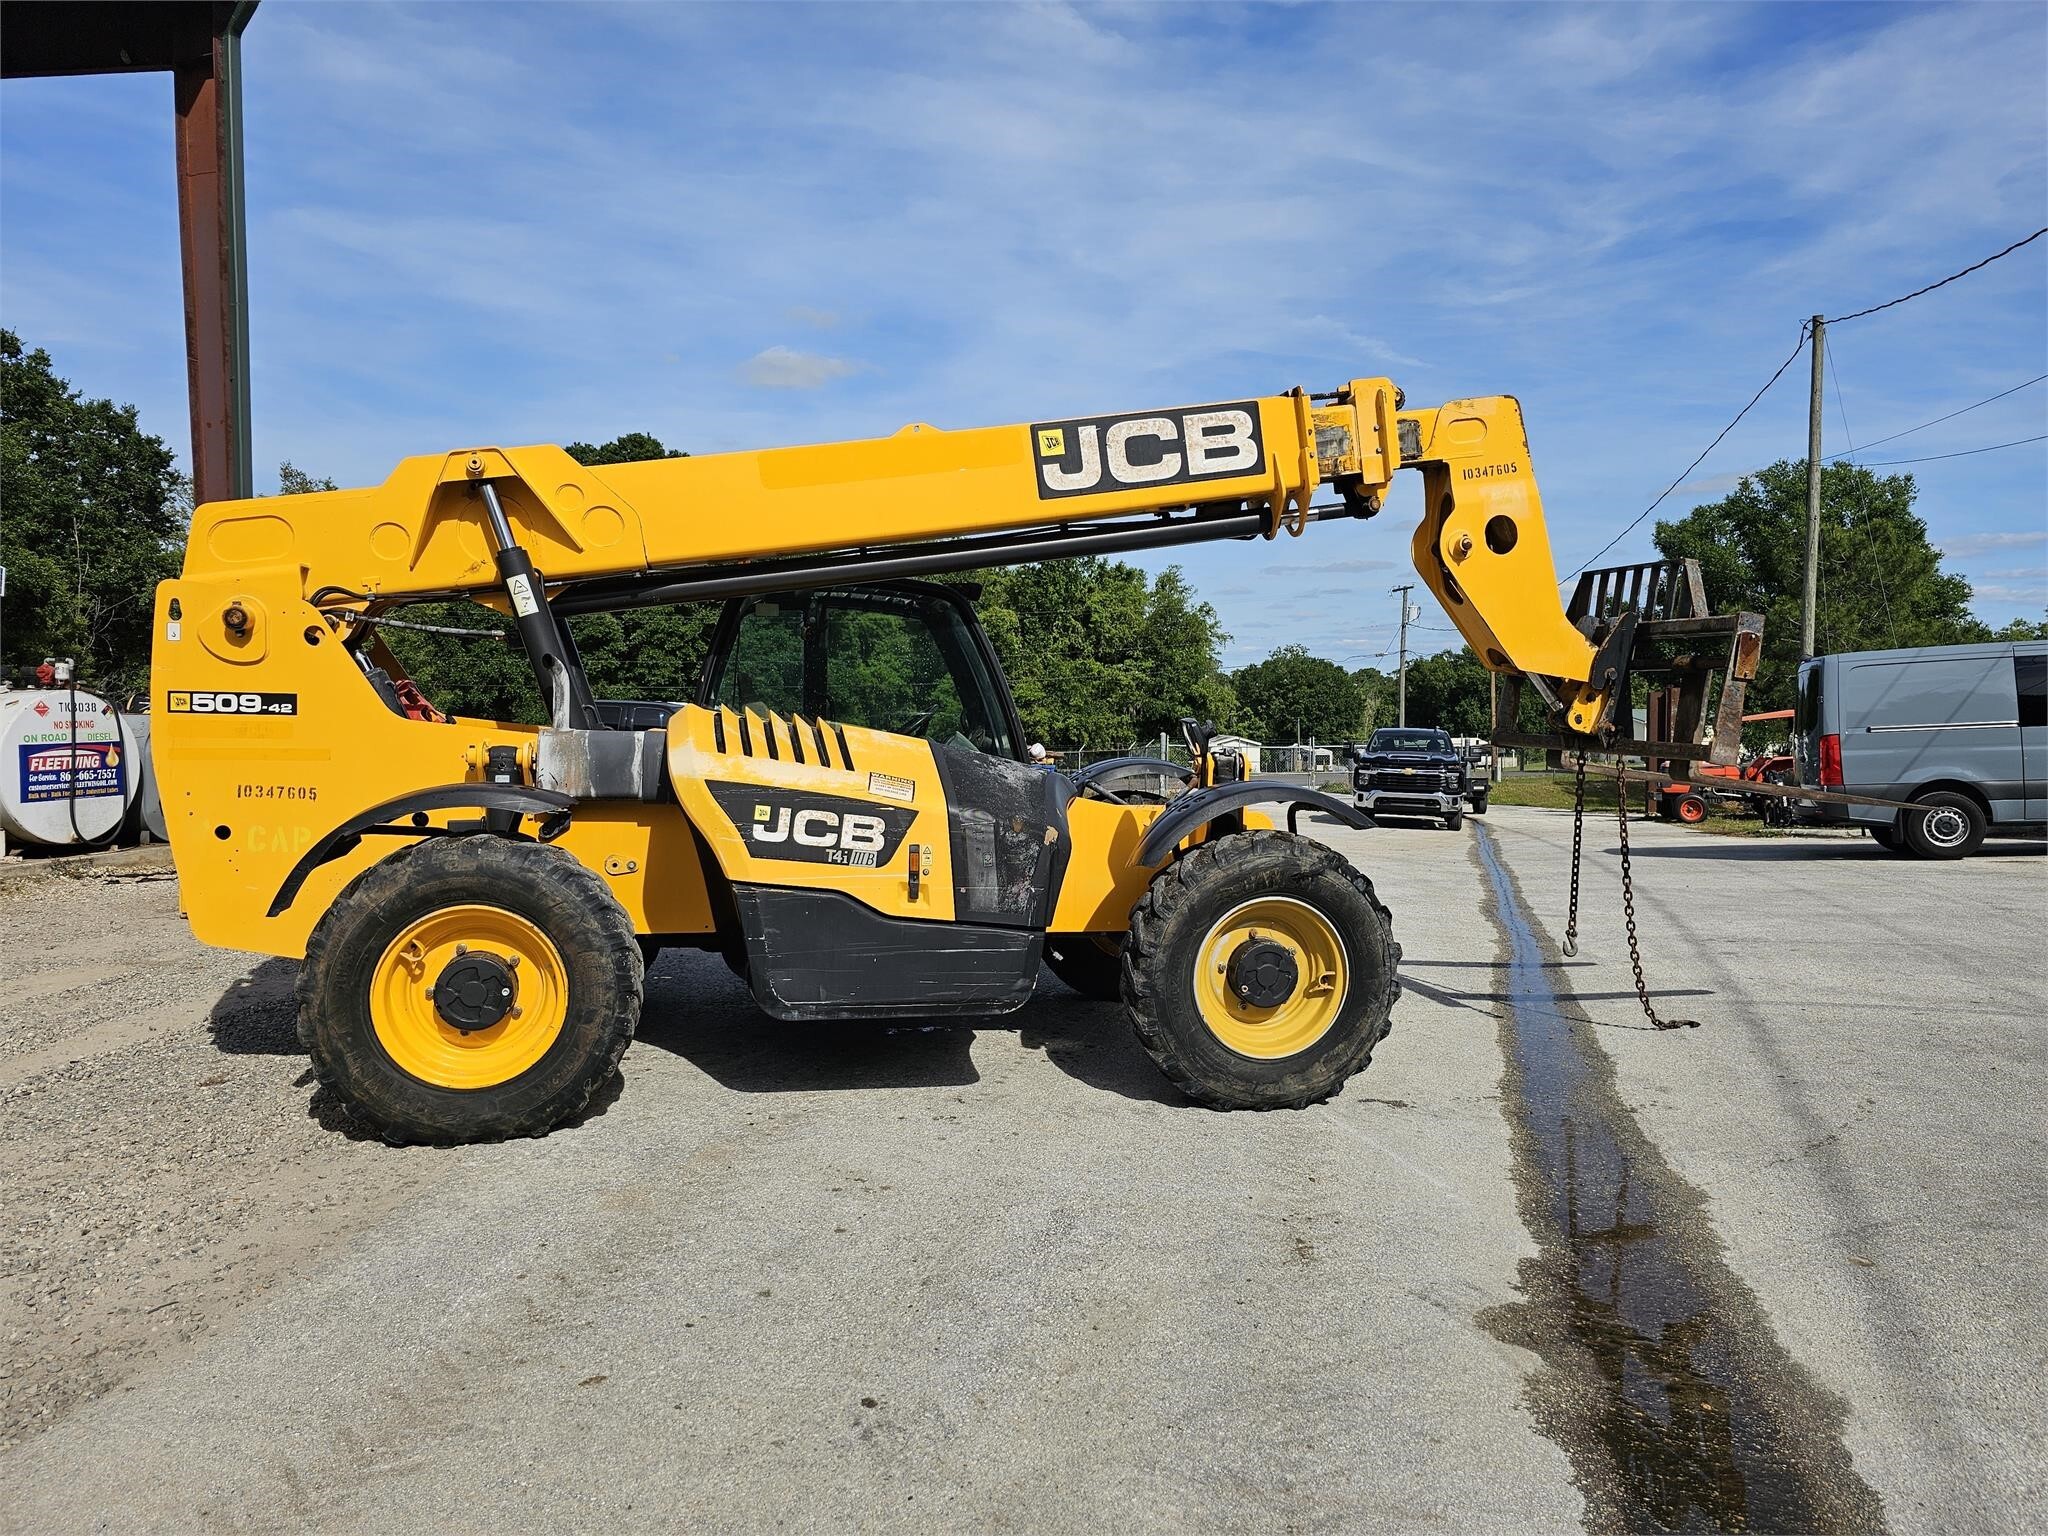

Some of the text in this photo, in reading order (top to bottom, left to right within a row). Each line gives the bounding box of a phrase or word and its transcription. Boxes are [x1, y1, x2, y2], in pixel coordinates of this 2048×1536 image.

[1042, 410, 1258, 491] JCB
[1045, 435, 1062, 450] JCB
[1462, 462, 1517, 480] 10347605
[192, 693, 293, 713] 509-42
[53, 721, 63, 729] NO
[23, 732, 113, 743] ON ROAD DIESEL
[60, 769, 117, 782] 86-665-7557
[871, 772, 914, 785] WARNING
[237, 784, 317, 801] 10347605
[752, 807, 886, 852] JCB
[247, 824, 312, 853] CAP
[826, 849, 849, 864] T4i
